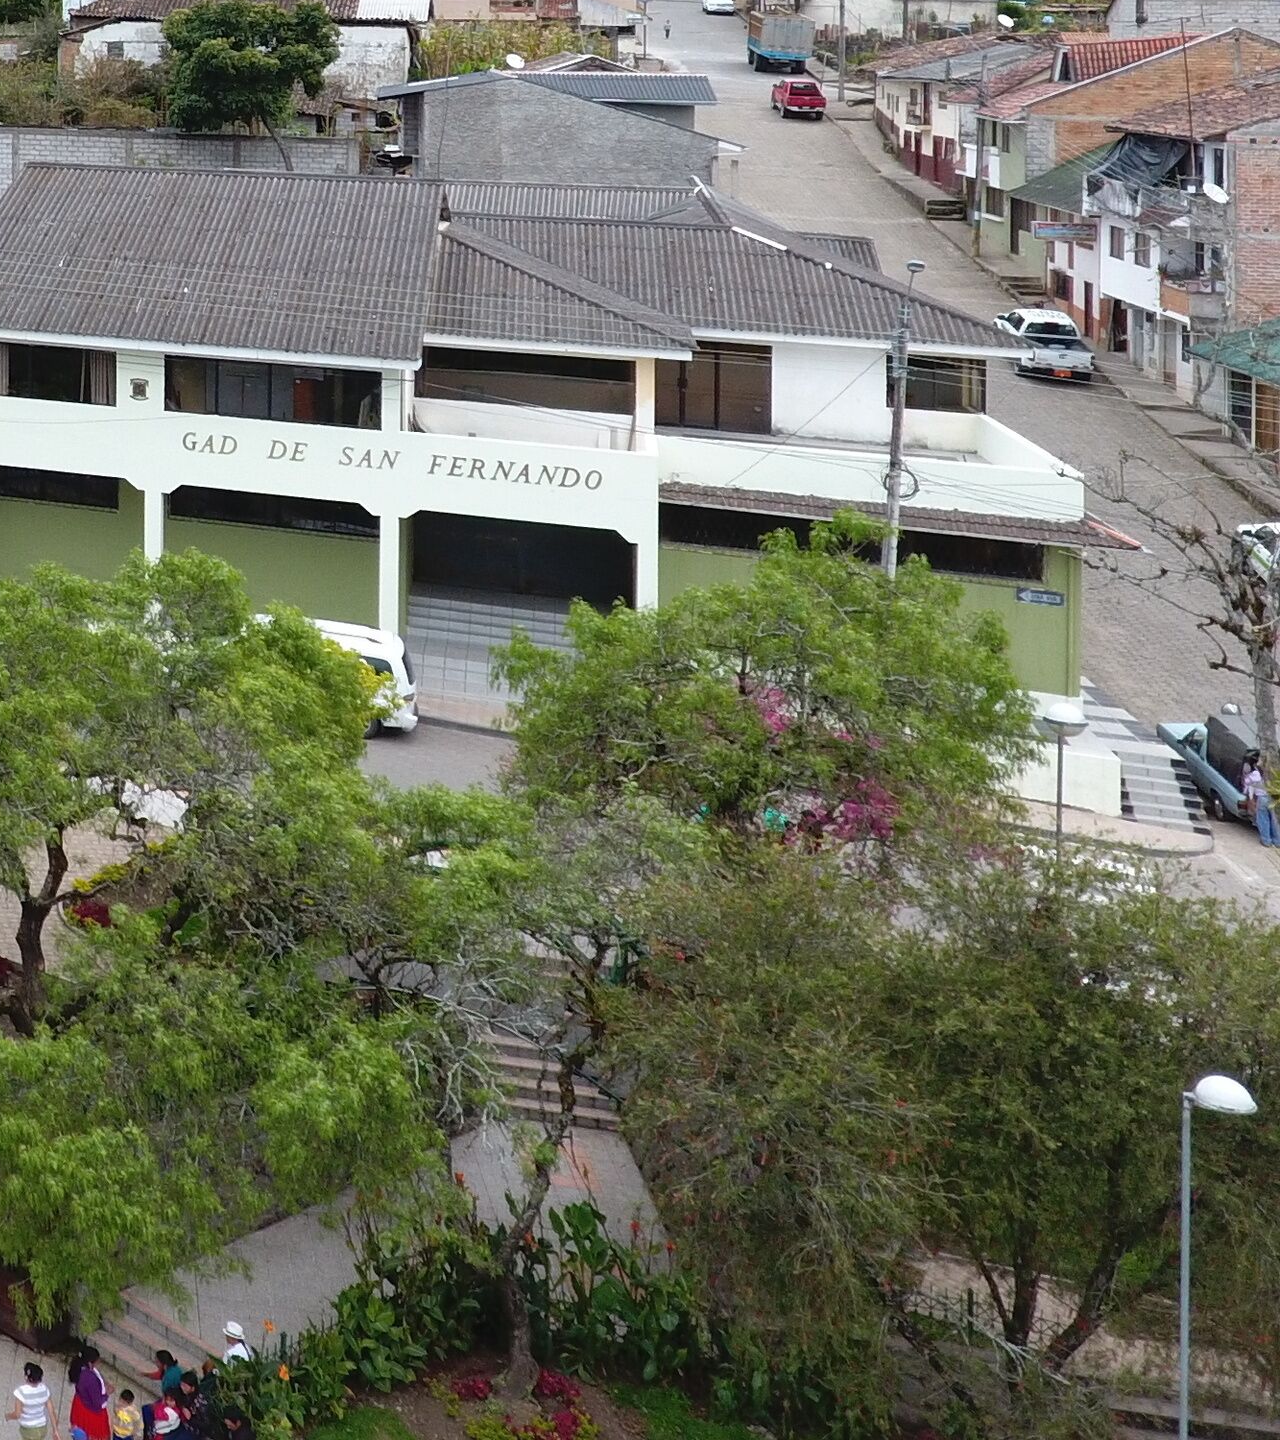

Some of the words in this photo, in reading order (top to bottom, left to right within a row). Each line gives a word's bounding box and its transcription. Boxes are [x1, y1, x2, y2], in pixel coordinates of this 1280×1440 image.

[182, 431, 238, 456] GAD
[266, 439, 309, 462] DE
[338, 446, 401, 470] SAN
[427, 454, 604, 491] FERNANDO
